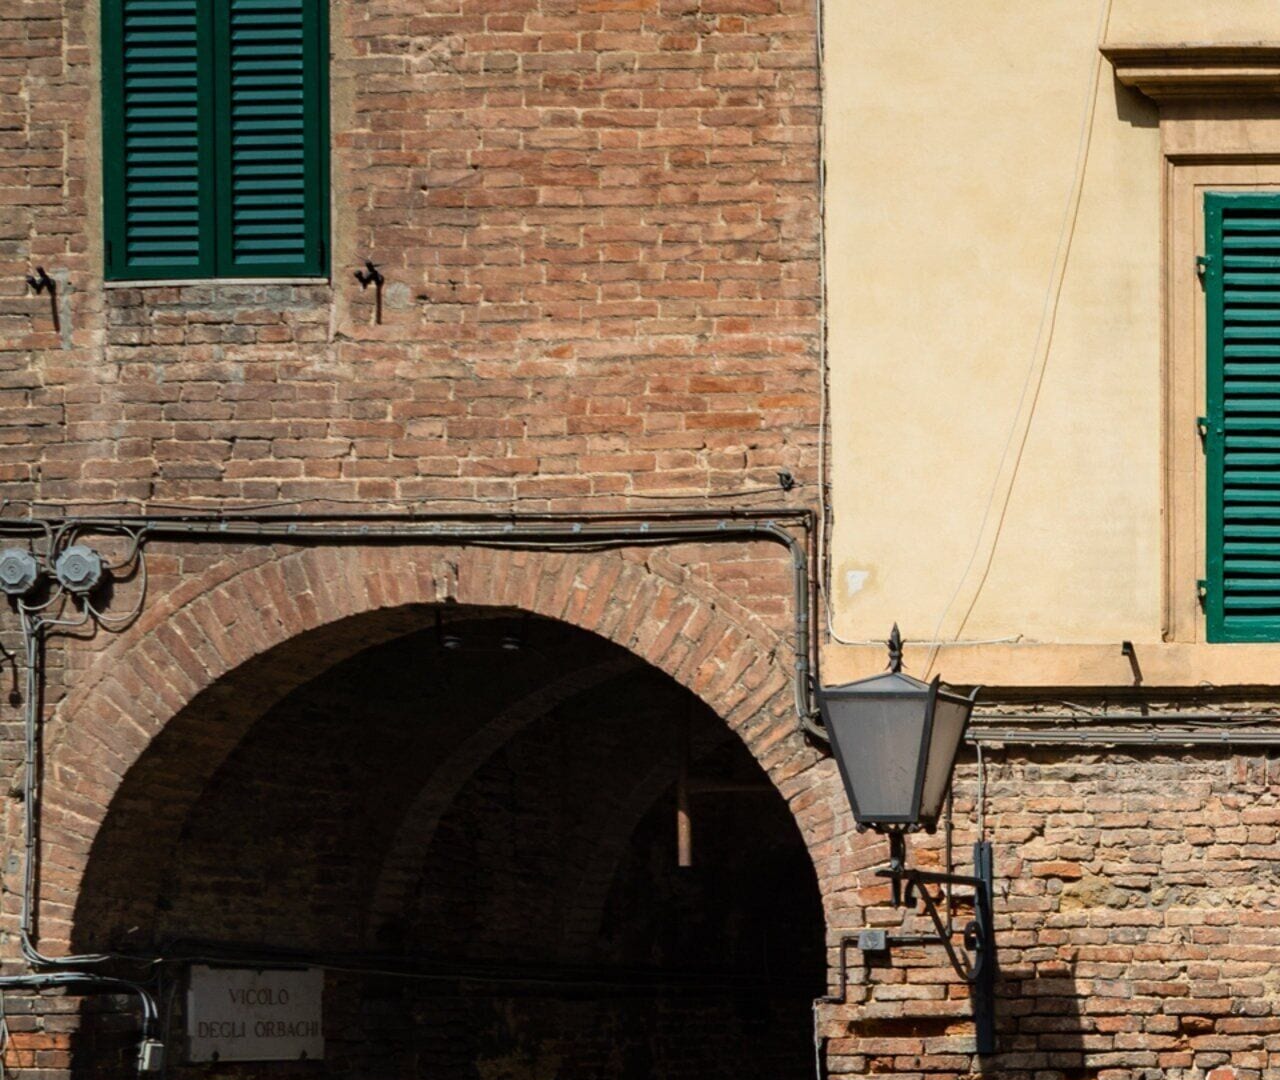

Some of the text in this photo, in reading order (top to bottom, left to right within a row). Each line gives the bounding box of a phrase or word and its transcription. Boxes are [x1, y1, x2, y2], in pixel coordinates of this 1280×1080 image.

[228, 988, 290, 1006] VICOLO
[198, 1020, 319, 1038] DEGLI ORBACHI
